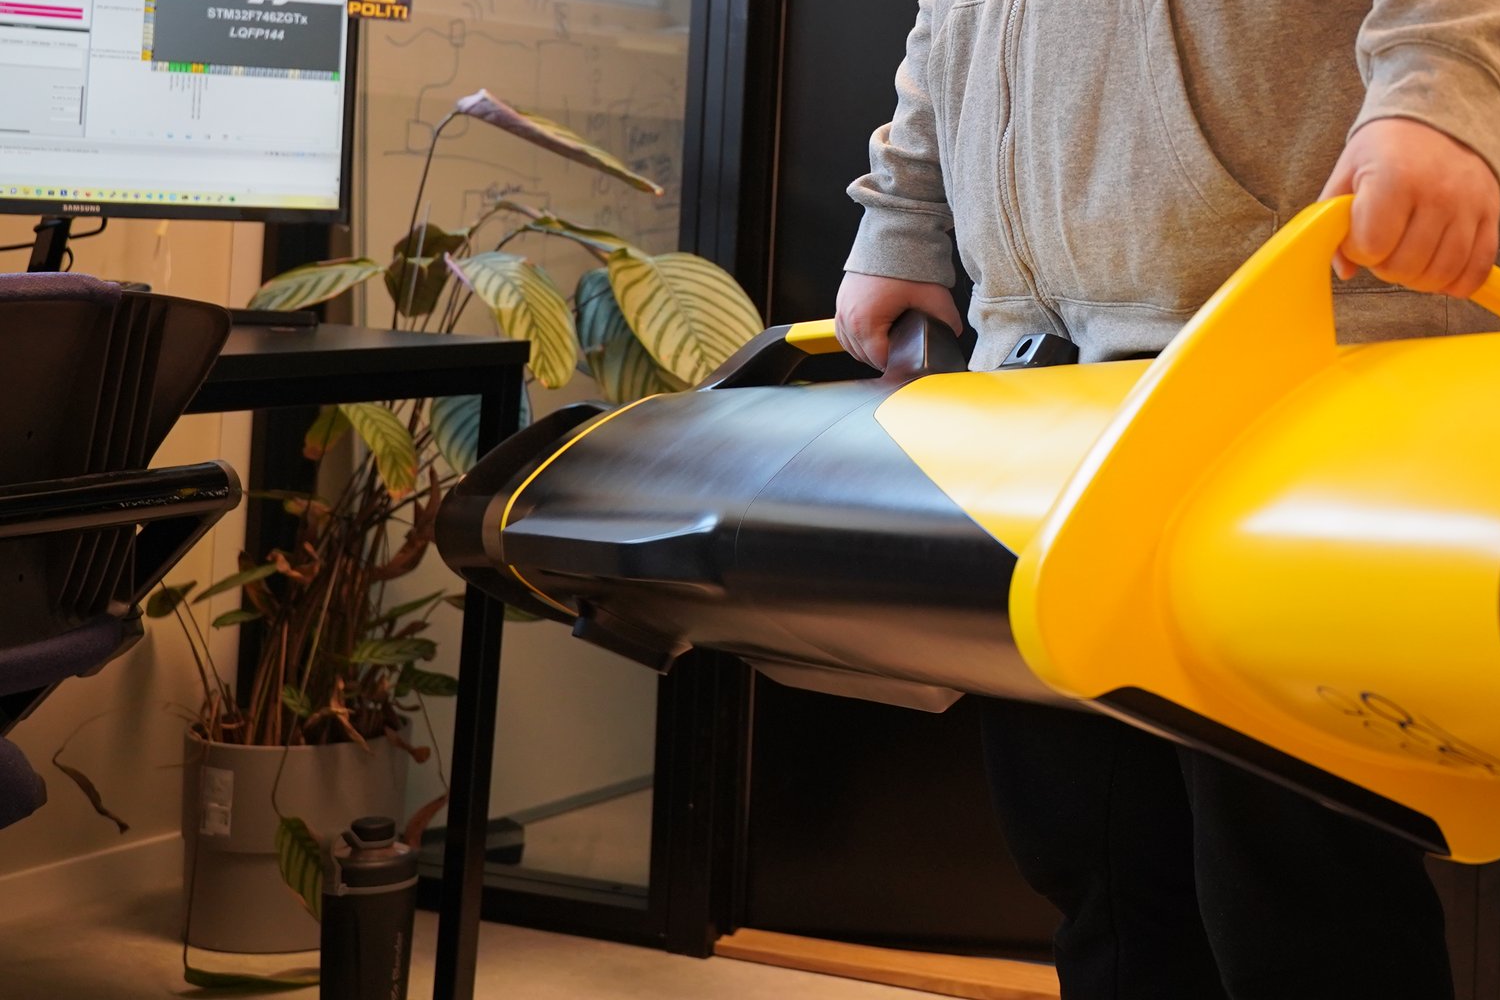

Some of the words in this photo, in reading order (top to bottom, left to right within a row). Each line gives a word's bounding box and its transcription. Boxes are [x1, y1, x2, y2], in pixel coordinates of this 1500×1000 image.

[207, 6, 308, 25] STM32F746ZGTx
[348, 1, 408, 19] POLITI
[229, 26, 285, 40] LQFP144
